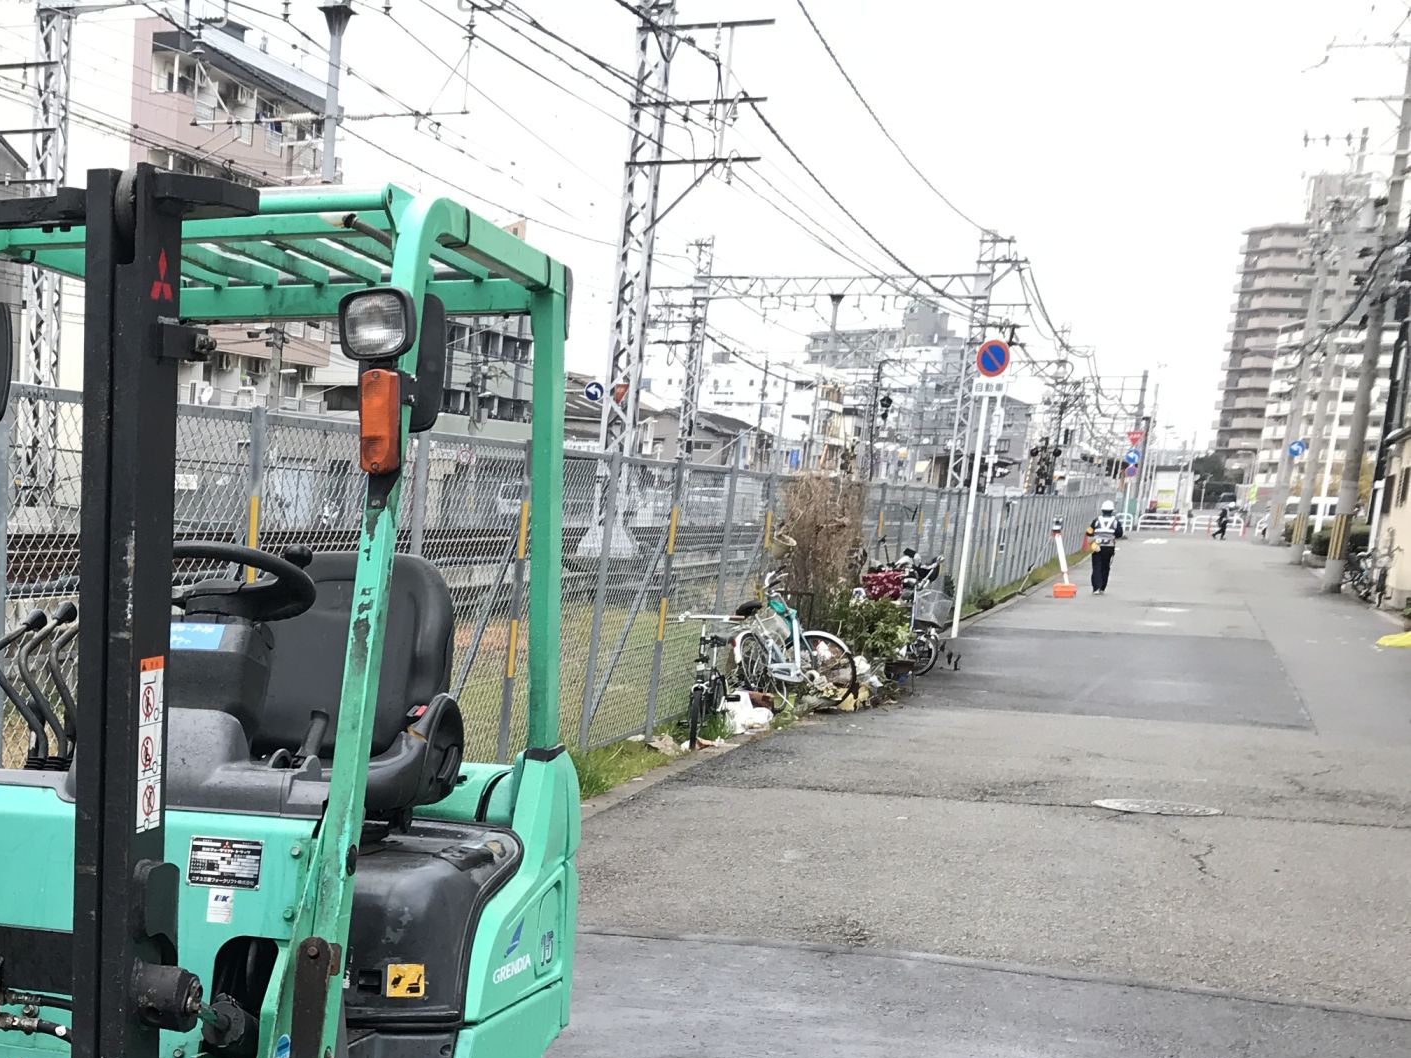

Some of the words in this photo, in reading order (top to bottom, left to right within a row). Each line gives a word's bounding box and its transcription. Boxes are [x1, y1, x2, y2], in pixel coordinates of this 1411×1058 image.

[974, 383, 1004, 393] 自動車
[540, 930, 555, 967] 15
[492, 953, 532, 985] GRENDIA
